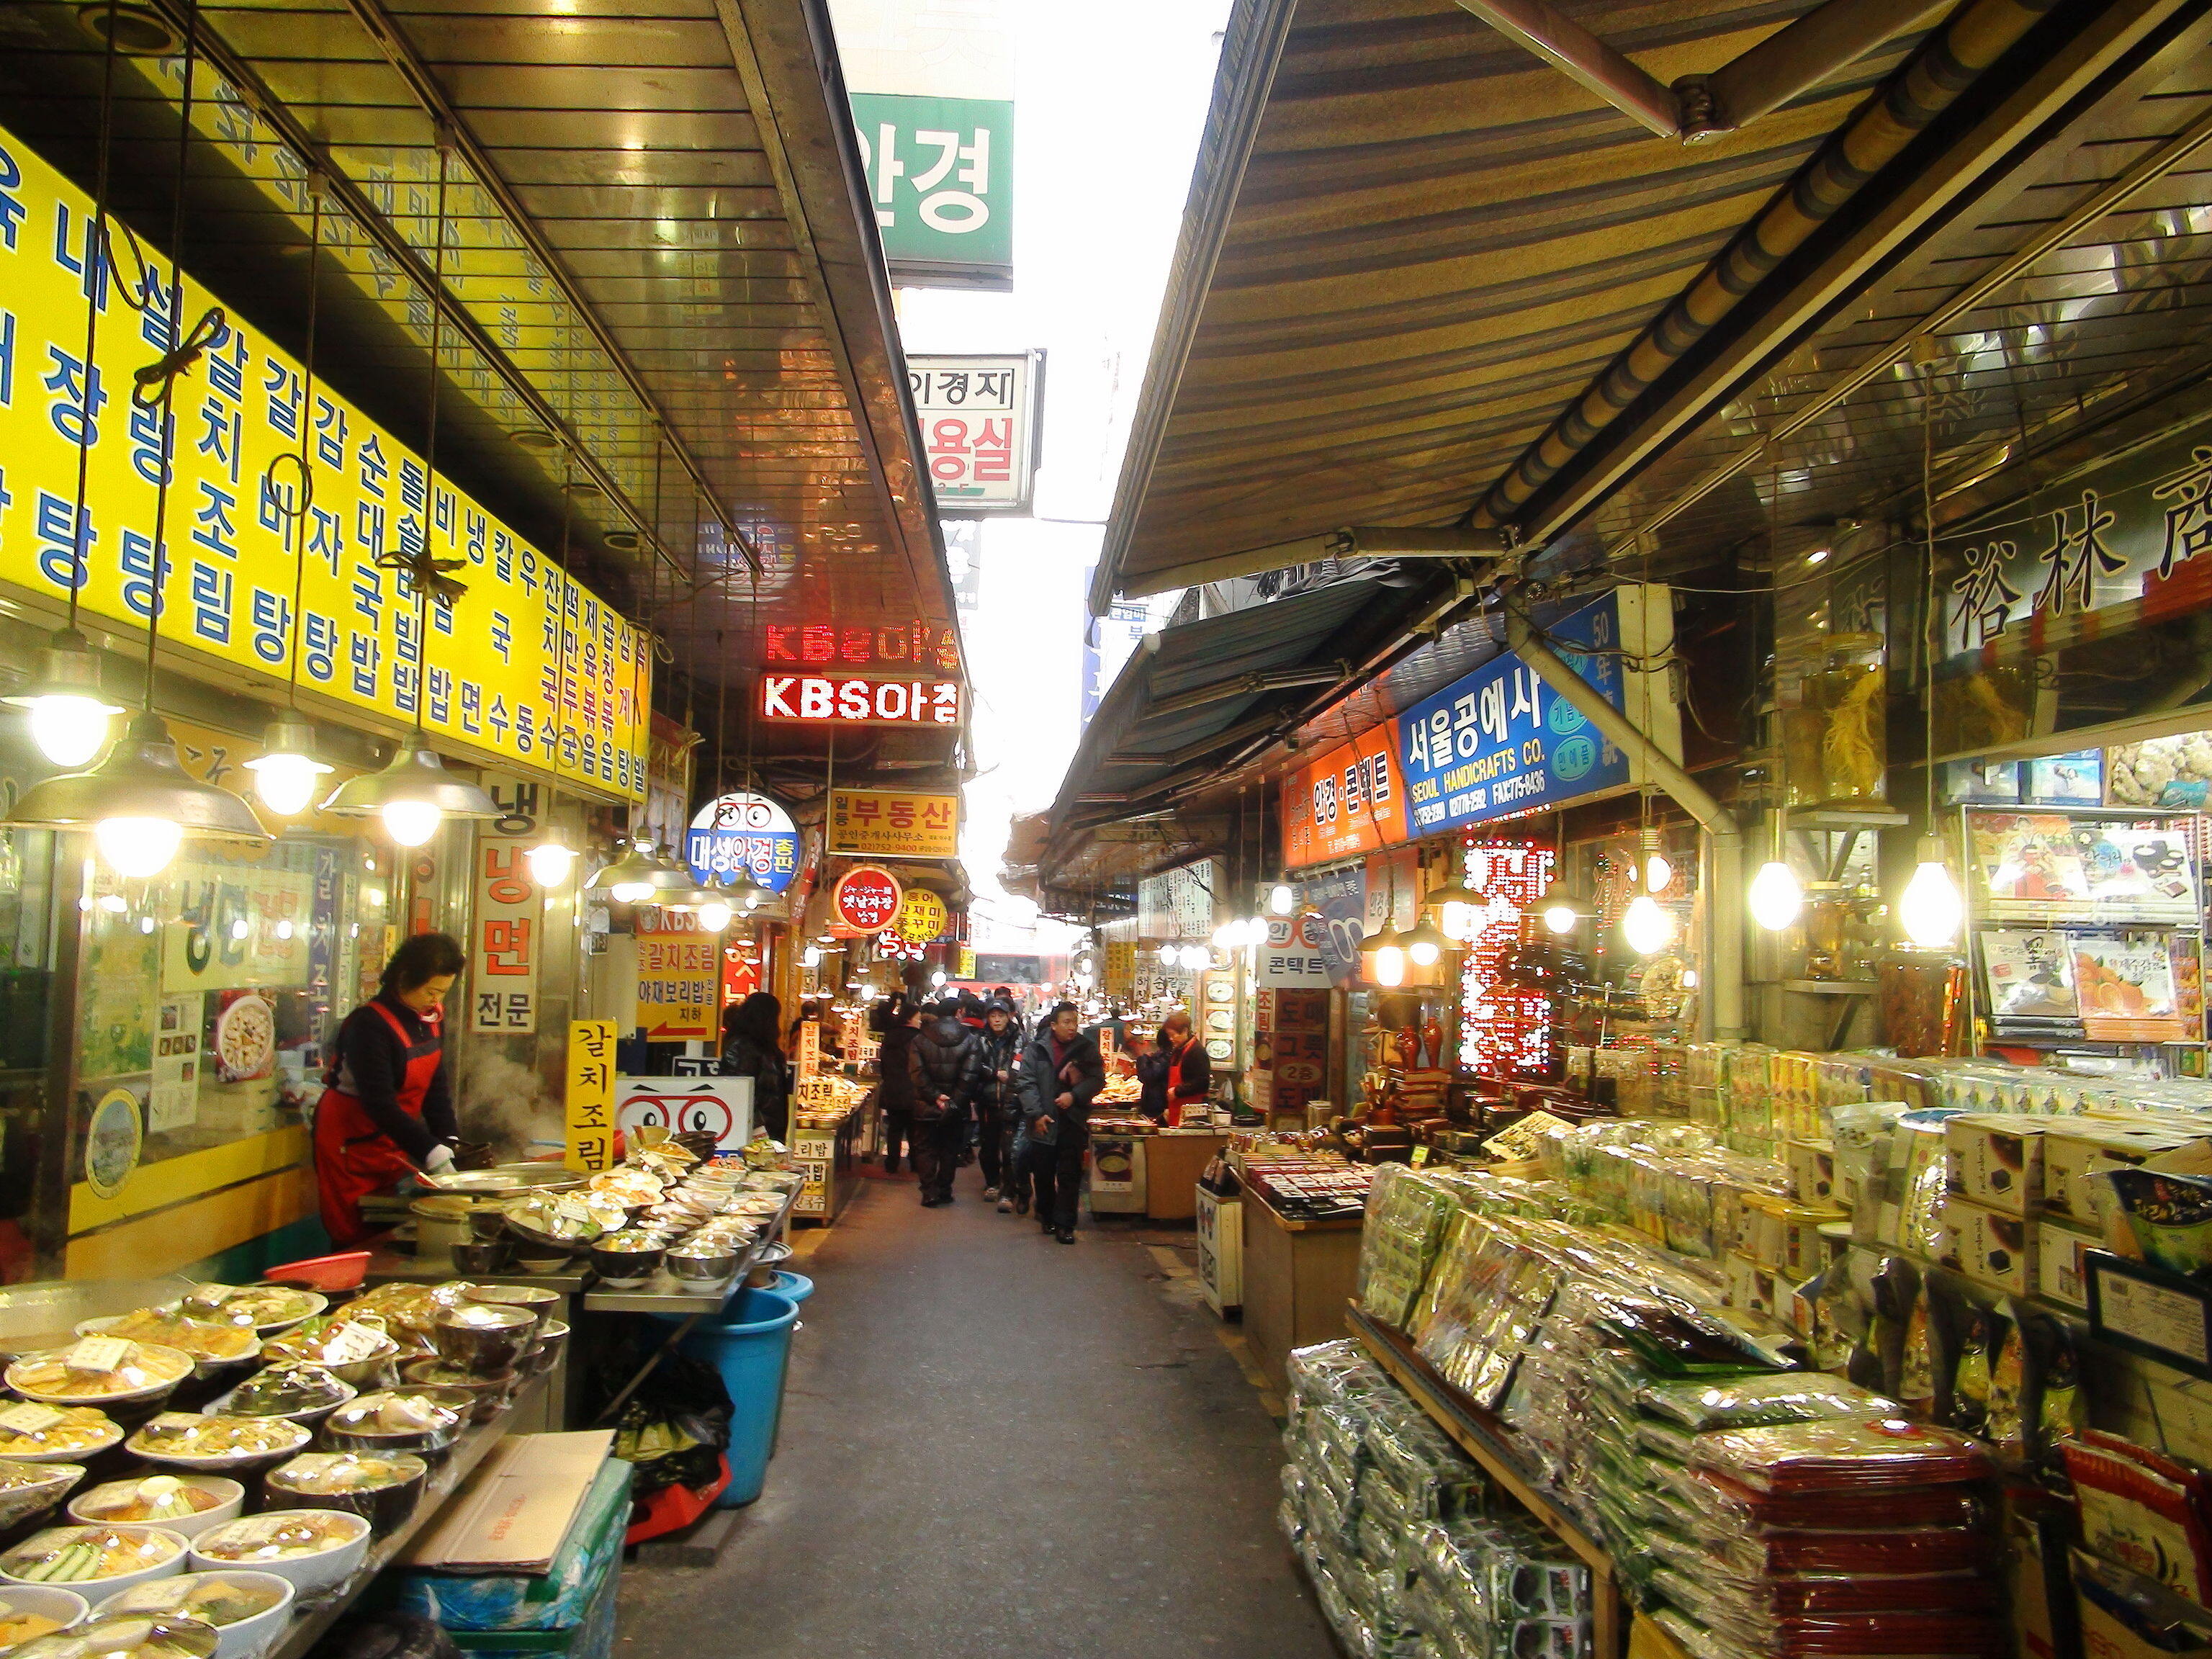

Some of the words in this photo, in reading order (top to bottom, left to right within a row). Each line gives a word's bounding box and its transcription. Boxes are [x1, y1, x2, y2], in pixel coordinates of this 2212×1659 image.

[37, 200, 109, 588] 내장탕
[122, 264, 183, 616] 설렁탕
[919, 418, 1013, 481] 용실
[253, 358, 302, 663] 갈비탕
[305, 396, 348, 681] 감자탕
[351, 432, 389, 698] 순대국밥
[462, 508, 486, 733] 냉면
[490, 530, 513, 742] 칼국수
[515, 554, 538, 752] 우동
[540, 567, 560, 760] 잔치국수
[562, 582, 579, 766] 떡만두국
[583, 599, 598, 775] 제육볶음
[601, 611, 615, 782] 곱창볶음
[618, 623, 631, 788] 삼계탕
[634, 632, 646, 793] 족발
[1409, 667, 1542, 773] 서울공예사
[1411, 777, 1440, 804] SEOUL
[1443, 747, 1516, 794] HANDICRAFTS
[1521, 737, 1546, 766] CO.
[691, 835, 773, 875] 대성안경
[773, 839, 795, 873] 총판
[852, 799, 951, 829] 부동산
[484, 847, 532, 976] 냉면
[649, 942, 716, 972] 갈치조림
[842, 894, 894, 910] 옛날자장
[477, 992, 531, 1028] 전문
[639, 980, 705, 1004] 야채보리밥
[680, 1008, 702, 1022] 지하
[571, 1024, 613, 1172] 갈치조림
